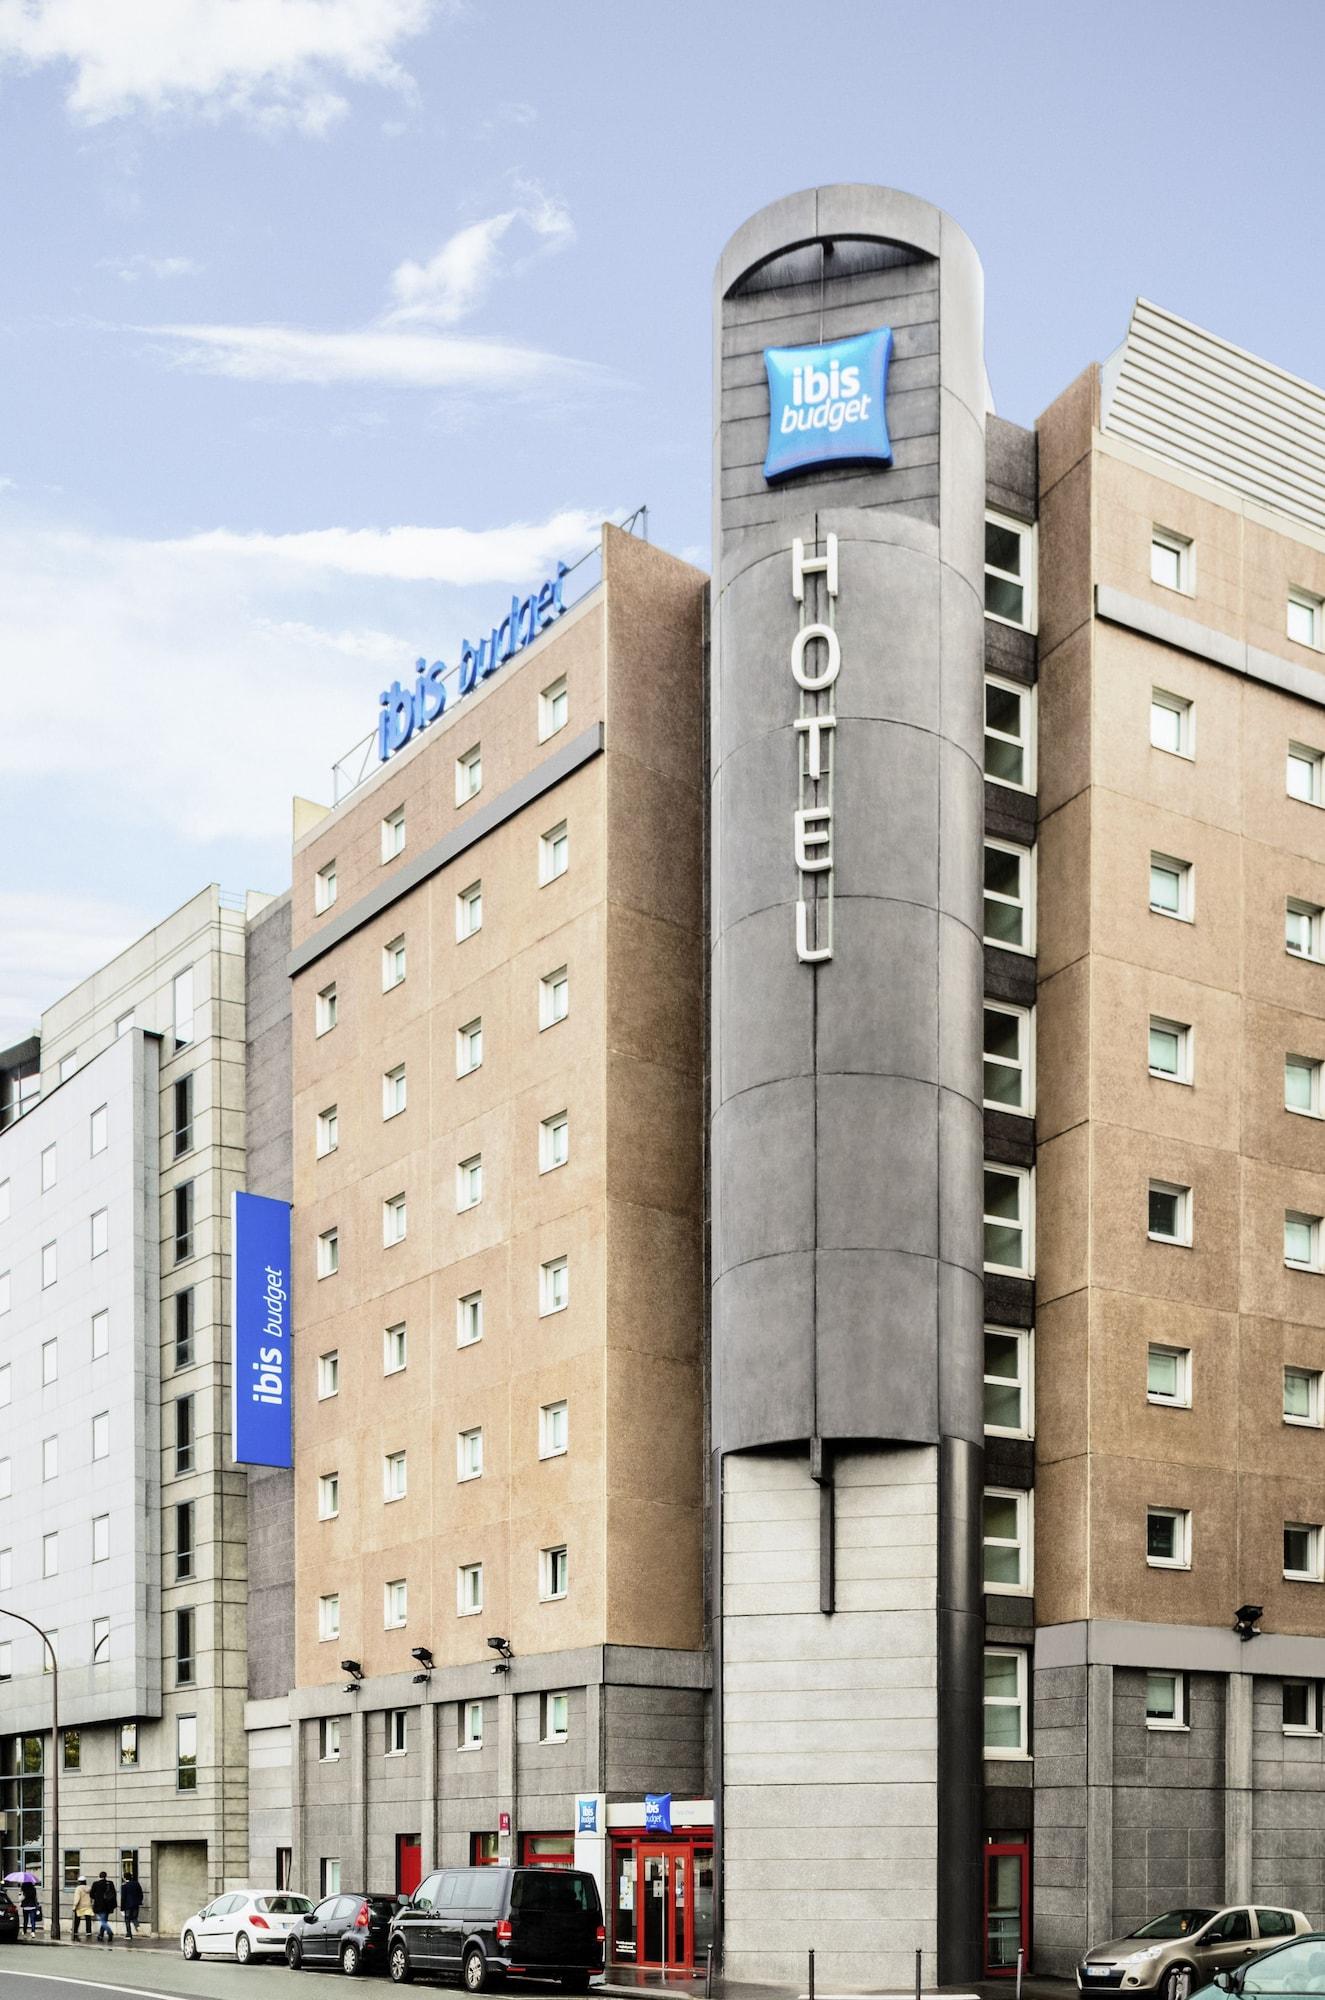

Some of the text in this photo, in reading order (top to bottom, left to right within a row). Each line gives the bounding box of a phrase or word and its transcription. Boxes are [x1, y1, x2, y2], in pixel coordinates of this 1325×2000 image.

[792, 359, 861, 406] ibis
[780, 394, 872, 434] budget
[378, 560, 571, 762] ibis budget
[791, 532, 841, 963] HOTEL
[252, 1265, 287, 1405] ibis budget
[582, 1805, 594, 1816] ibis
[646, 1801, 660, 1814] ibis
